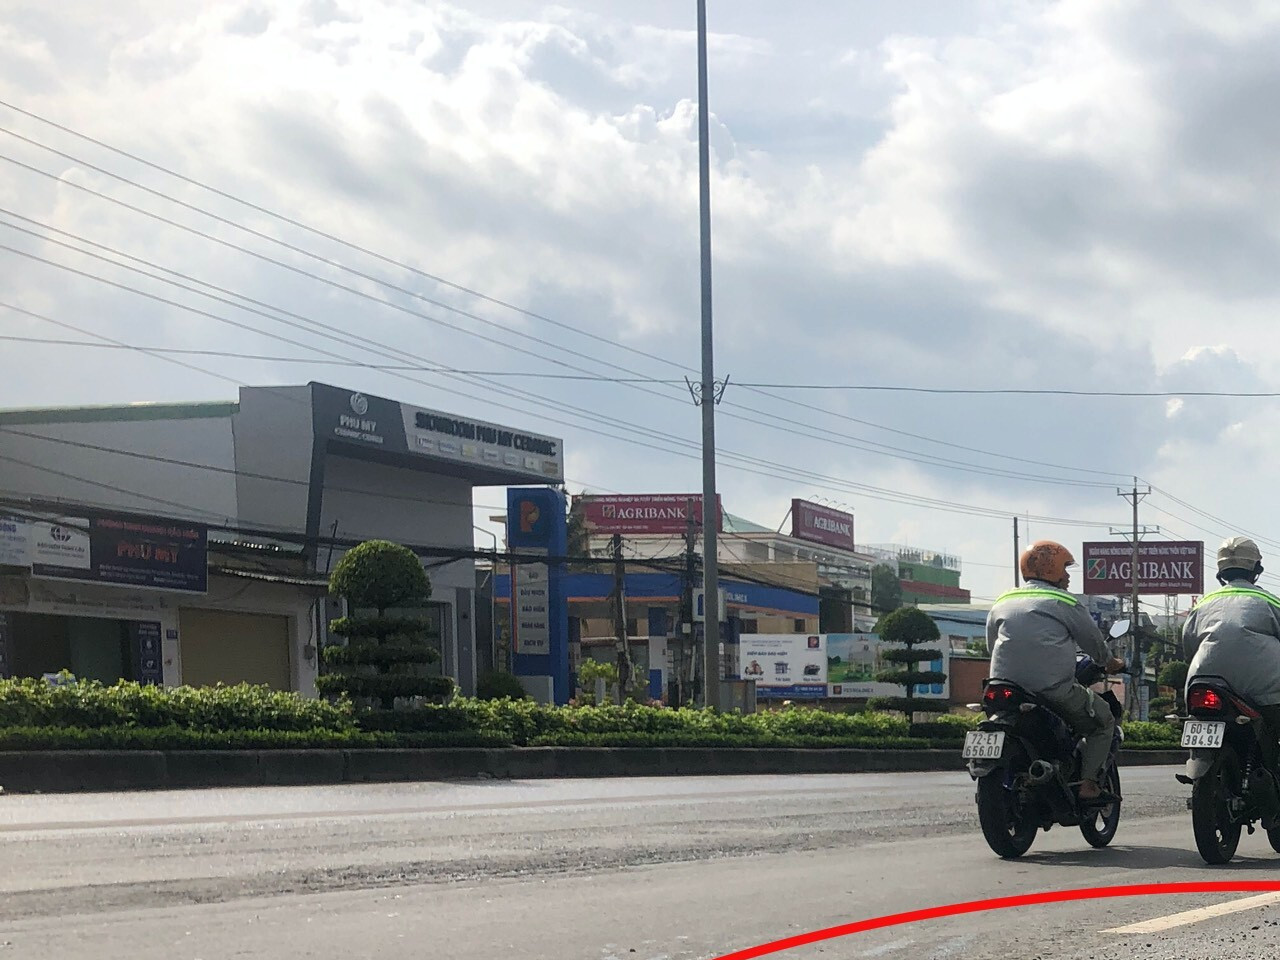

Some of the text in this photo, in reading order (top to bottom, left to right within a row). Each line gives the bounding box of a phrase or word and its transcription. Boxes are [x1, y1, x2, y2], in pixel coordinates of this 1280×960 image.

[617, 507, 686, 519] AGRIBANK
[813, 516, 851, 537] AGRIBANK
[971, 733, 998, 745] 72-E1
[1184, 734, 1220, 746] 384.94
[965, 745, 1001, 757] 656.00
